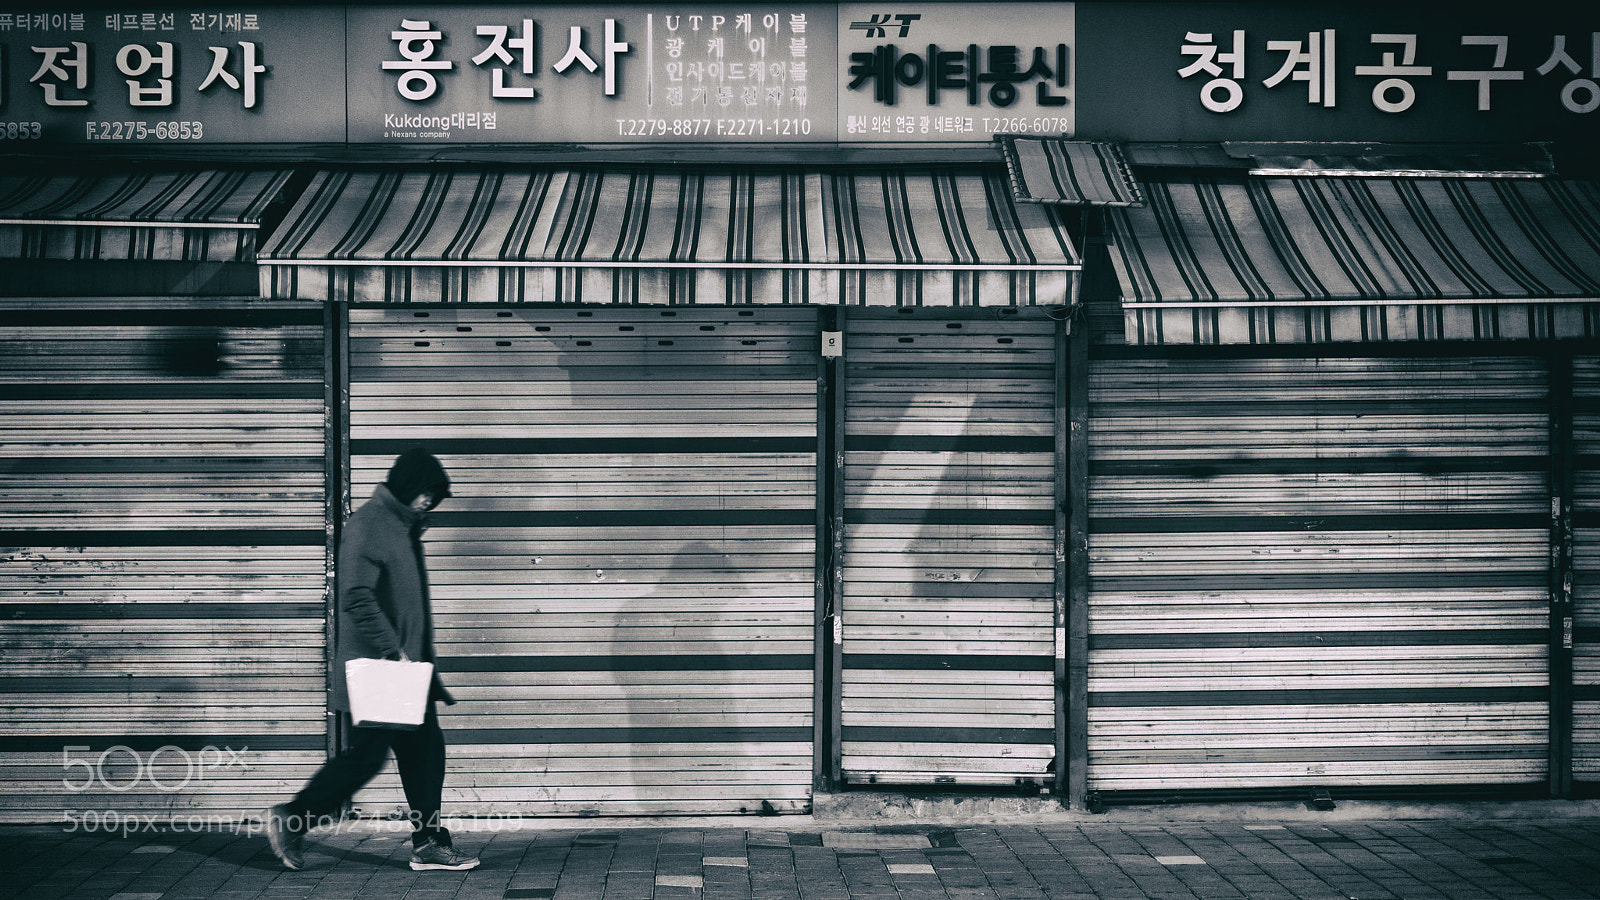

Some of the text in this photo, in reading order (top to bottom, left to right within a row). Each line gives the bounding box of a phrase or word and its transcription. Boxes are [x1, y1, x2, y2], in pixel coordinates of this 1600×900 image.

[105, 12, 175, 31] 테프론선
[189, 12, 260, 31] 전기재료
[849, 13, 921, 38] KT
[381, 18, 629, 102] 홍전사
[0, 41, 266, 109] 전업사
[848, 43, 1068, 107] 케이티통신
[86, 121, 203, 140] F.2275-6853
[616, 118, 811, 136] T.2279-8877 F.2271-1210
[846, 115, 867, 134] 통신
[871, 115, 891, 134] 외선
[919, 115, 930, 134] 광
[934, 115, 974, 134] 네트워크
[982, 117, 1068, 133] T.2266-6078
[419, 131, 451, 139] company
